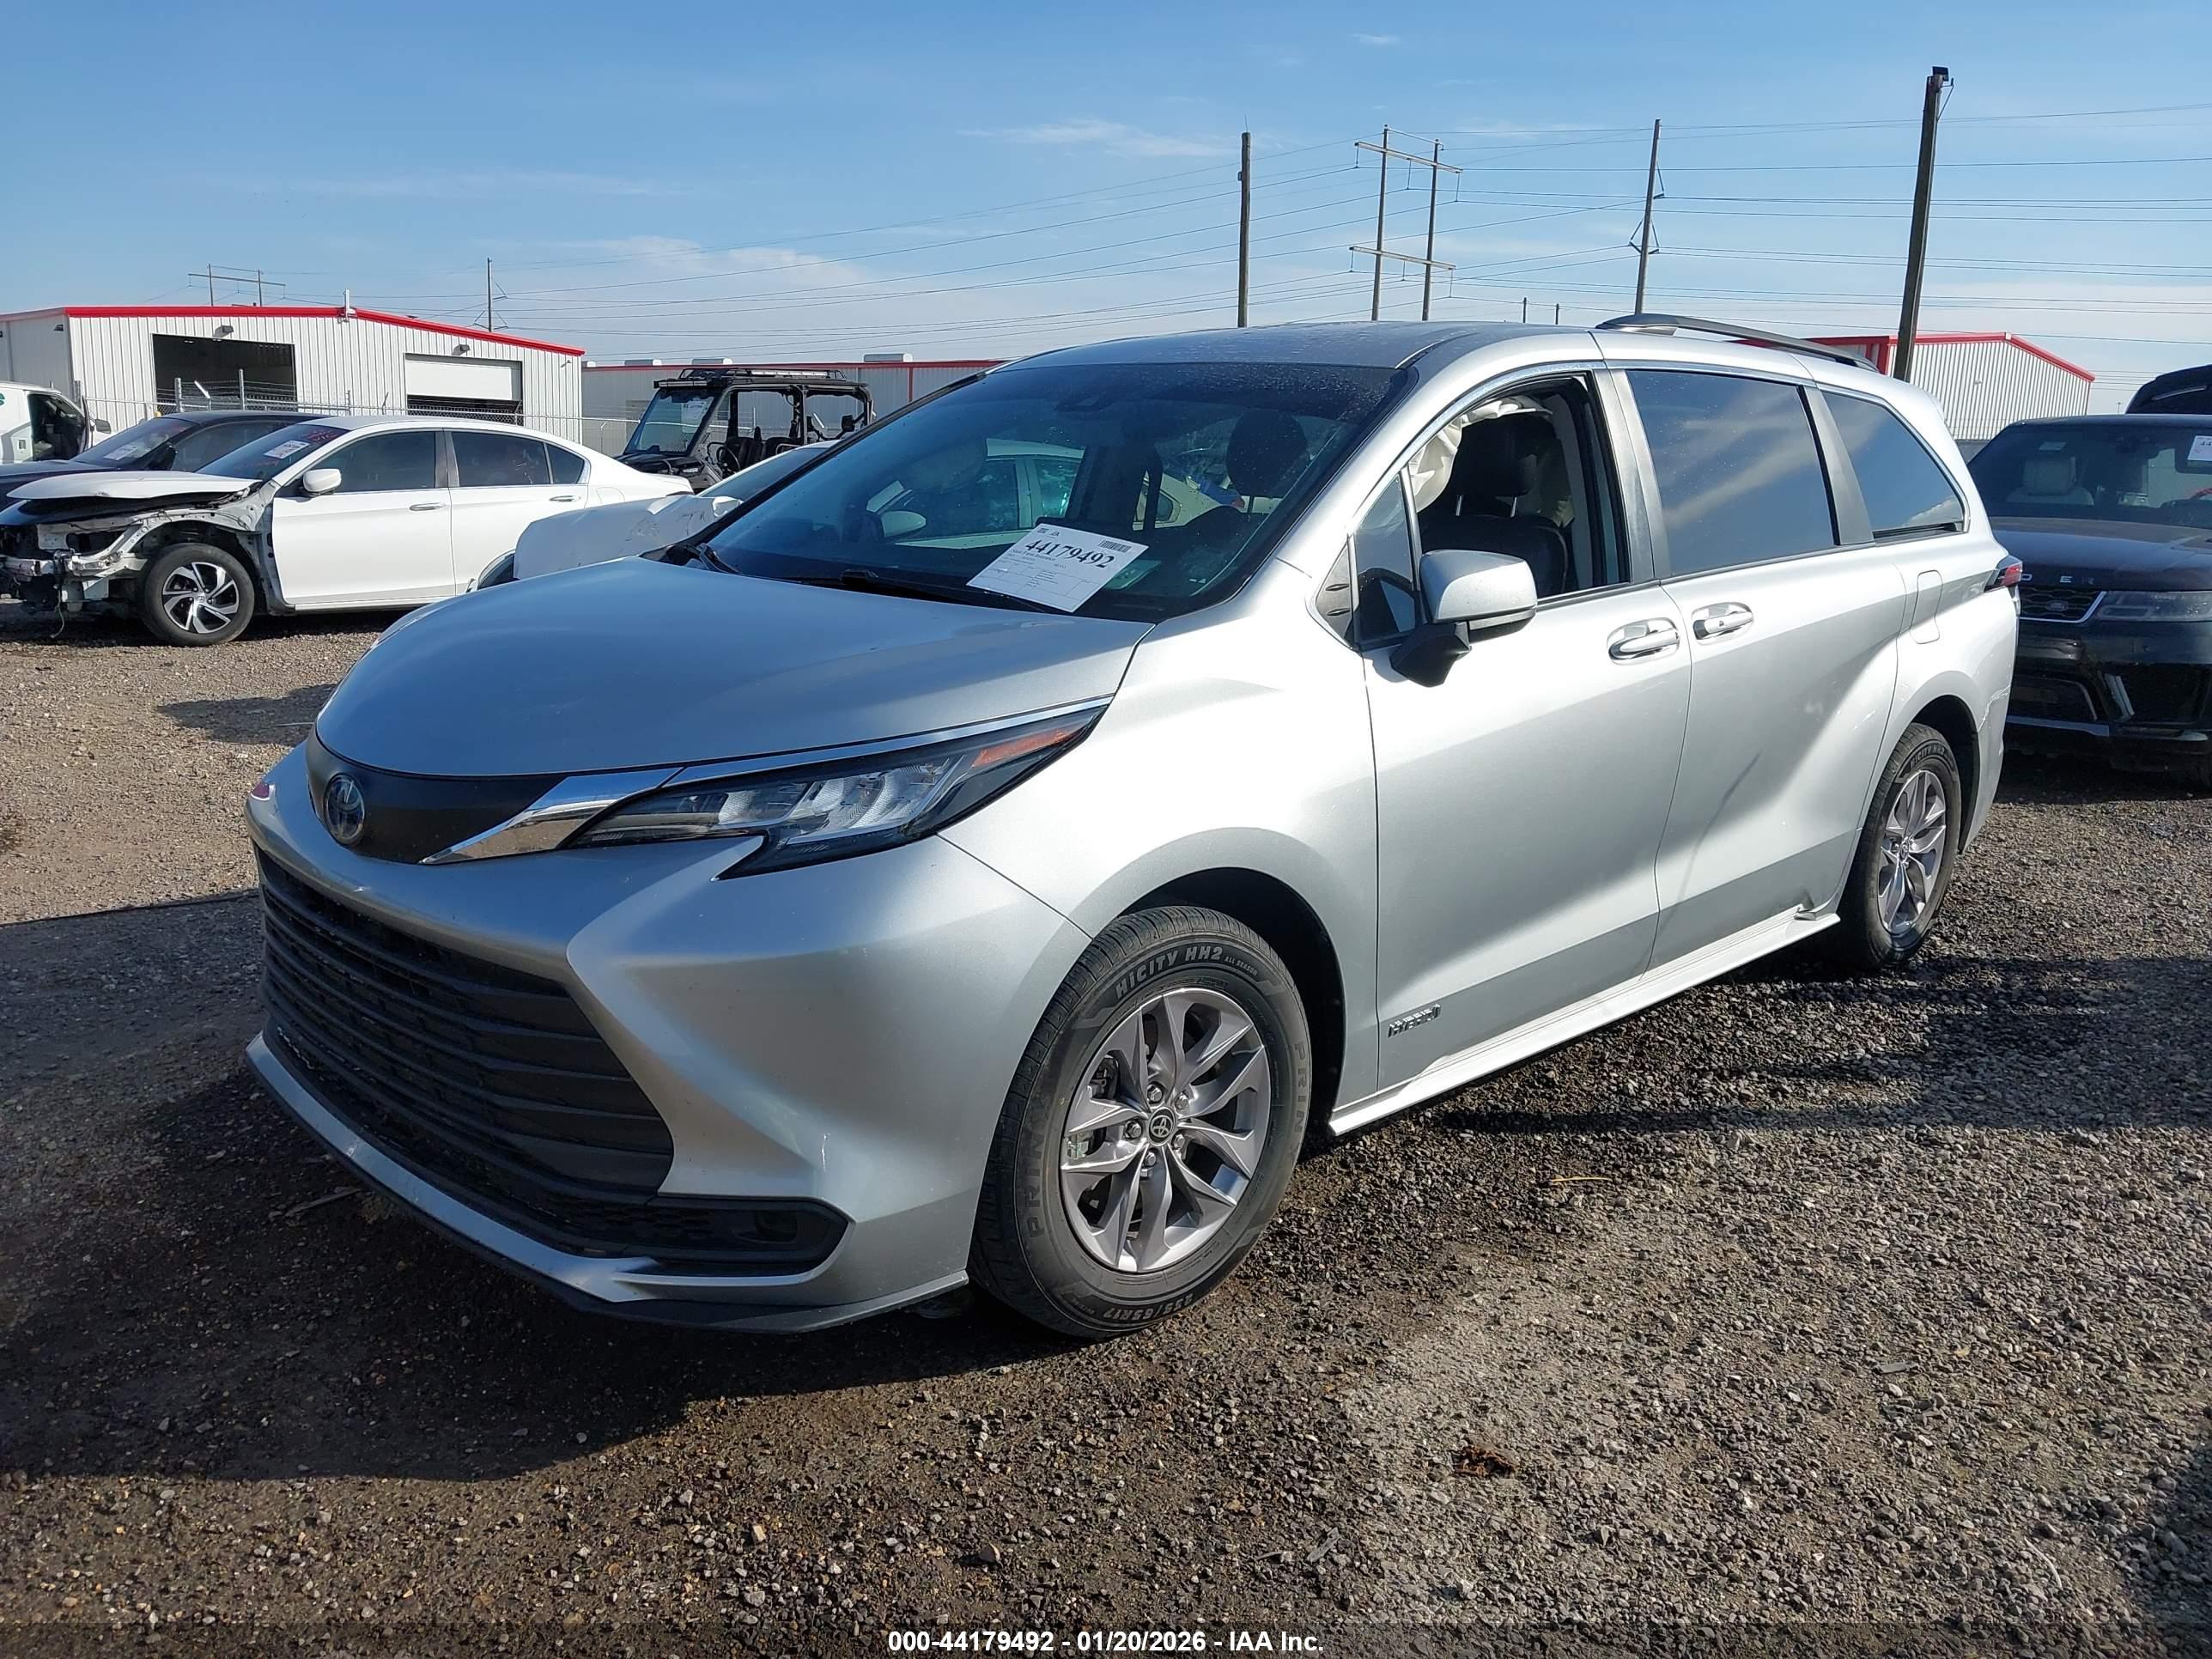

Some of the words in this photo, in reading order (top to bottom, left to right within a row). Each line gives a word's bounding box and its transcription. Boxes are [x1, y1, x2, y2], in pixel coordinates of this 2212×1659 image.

[1025, 539, 1115, 568] 44179492
[1185, 946, 1223, 962] HH2
[1224, 956, 1236, 964] ALL
[1236, 960, 1259, 976] SEASON
